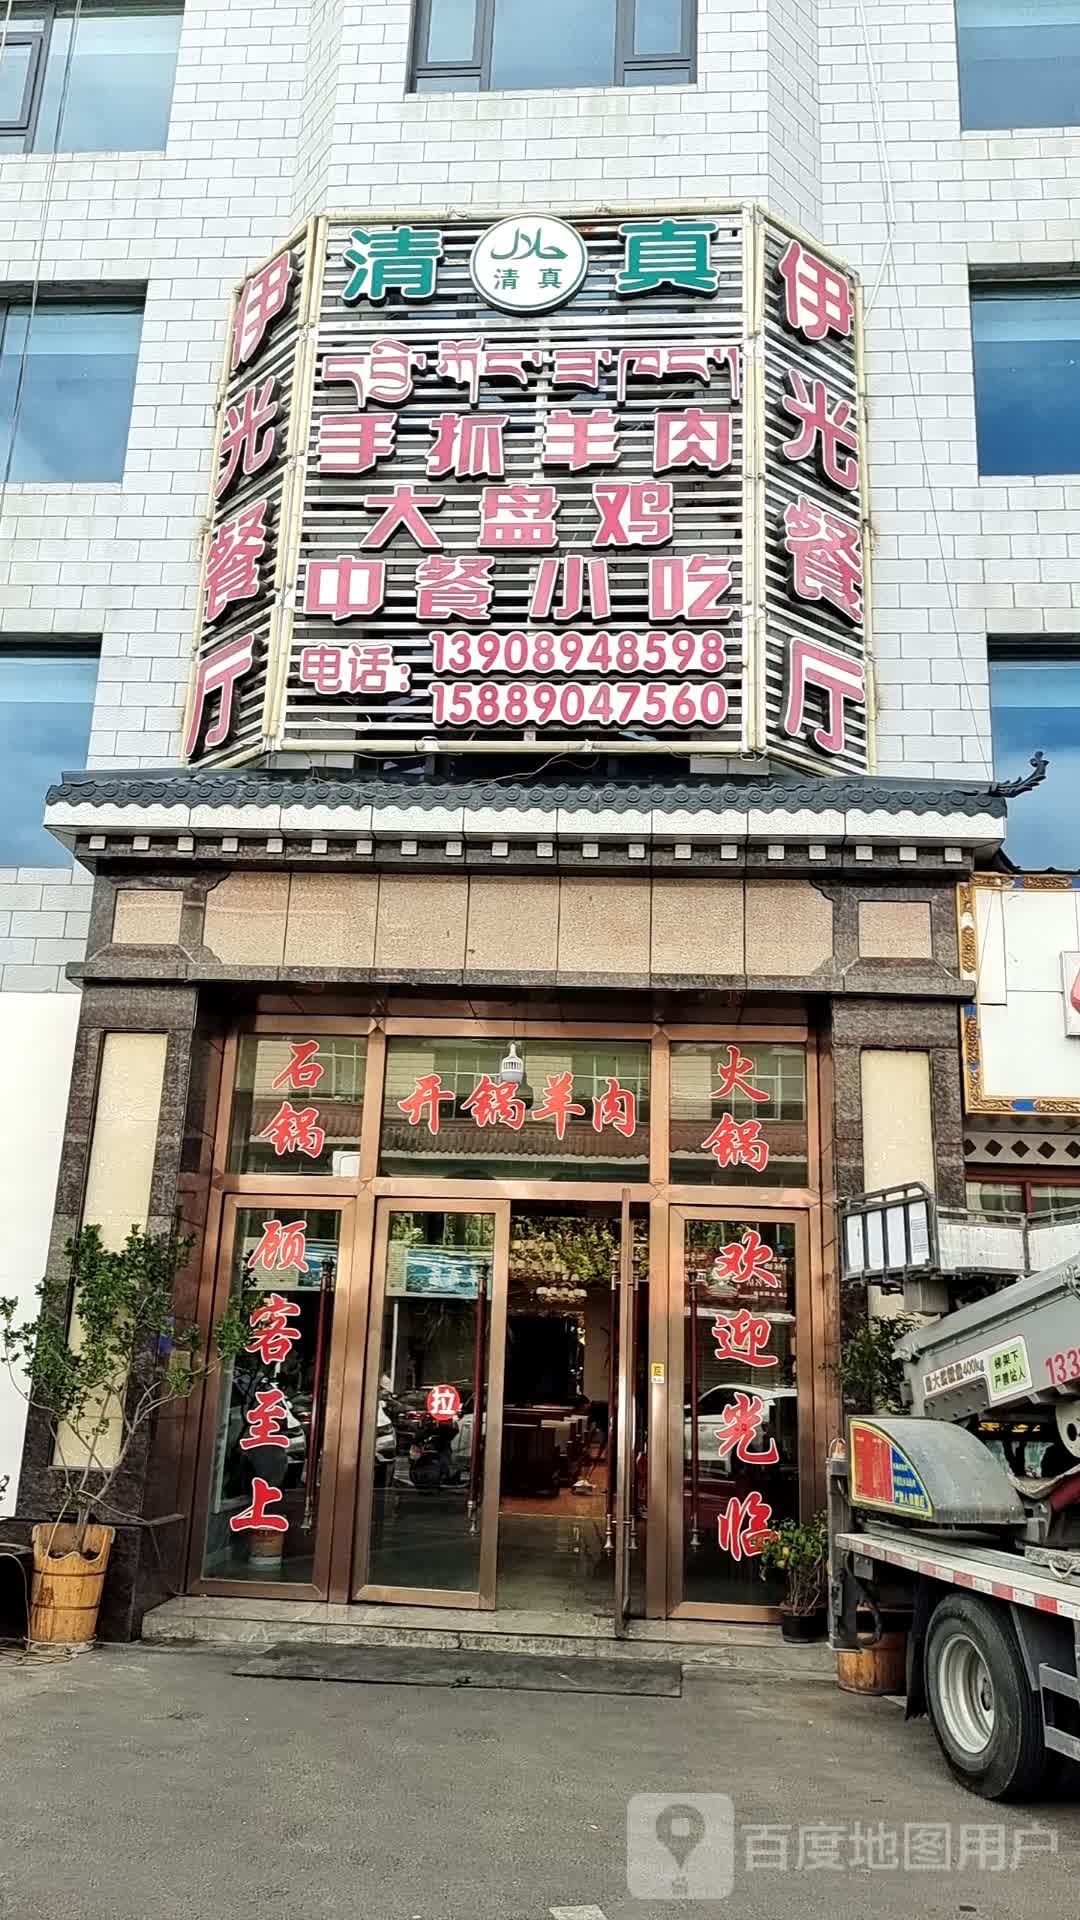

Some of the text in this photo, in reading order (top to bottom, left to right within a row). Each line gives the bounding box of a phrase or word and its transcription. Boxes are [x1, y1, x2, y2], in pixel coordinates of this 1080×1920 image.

[490, 227, 568, 260] حلال
[493, 267, 563, 290] 清真
[318, 409, 733, 477] 手抓羊肉
[185, 250, 292, 757] 伊光餐厅
[359, 484, 675, 549] 大盘鸡
[777, 240, 865, 755] 伊光餐厅
[304, 554, 732, 621] 中餐小吃
[429, 631, 726, 674] 13908948598
[429, 682, 727, 726] 15889047560
[260, 1040, 326, 1159] 石锅
[398, 1070, 636, 1140] 开锅羊肉
[700, 1044, 771, 1173] 火锅
[229, 1220, 310, 1533] 顾客至上
[711, 1230, 780, 1562] 欢迎光临
[1044, 1348, 1080, 1385] 133
[431, 1386, 457, 1415] 拉
